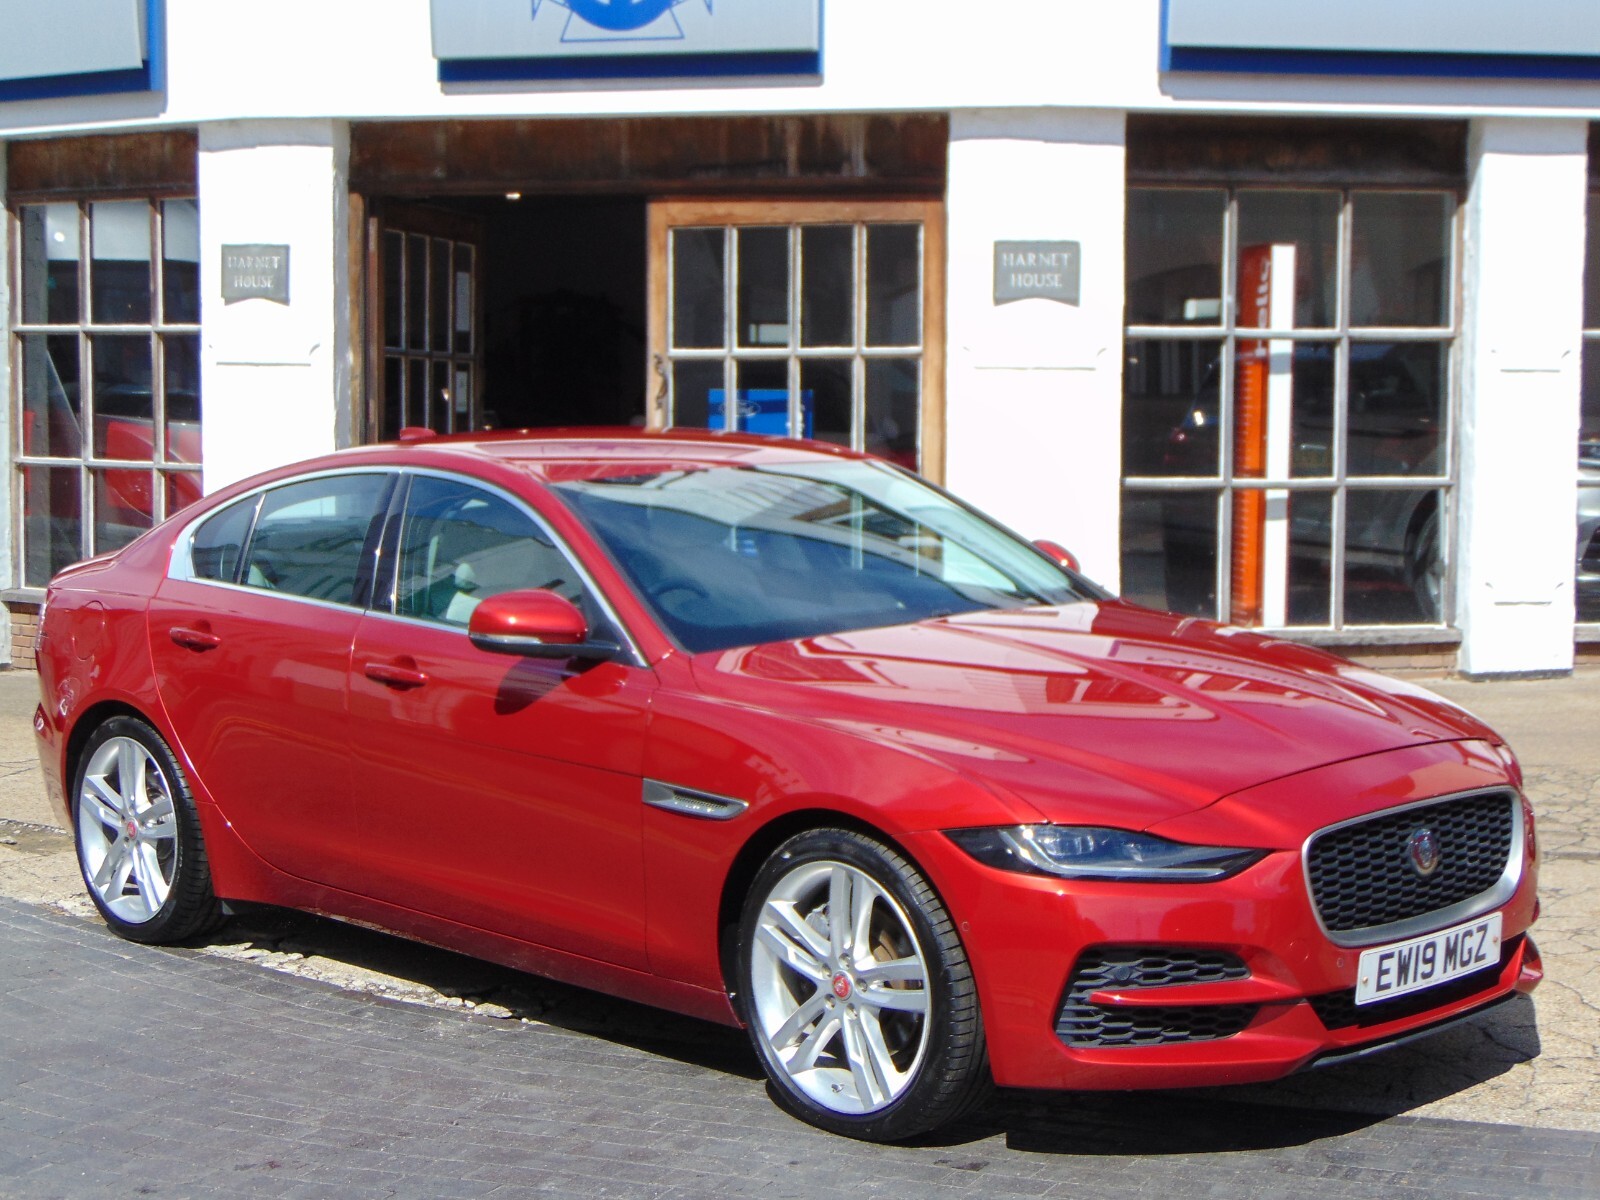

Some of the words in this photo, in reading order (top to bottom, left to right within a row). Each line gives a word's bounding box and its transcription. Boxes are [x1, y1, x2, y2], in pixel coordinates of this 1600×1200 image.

[1002, 252, 1071, 266] HARNET
[234, 275, 274, 288] HOUSE
[1011, 273, 1063, 288] HOUSE
[1375, 940, 1437, 993] EW19
[1443, 922, 1489, 974] MGZ
